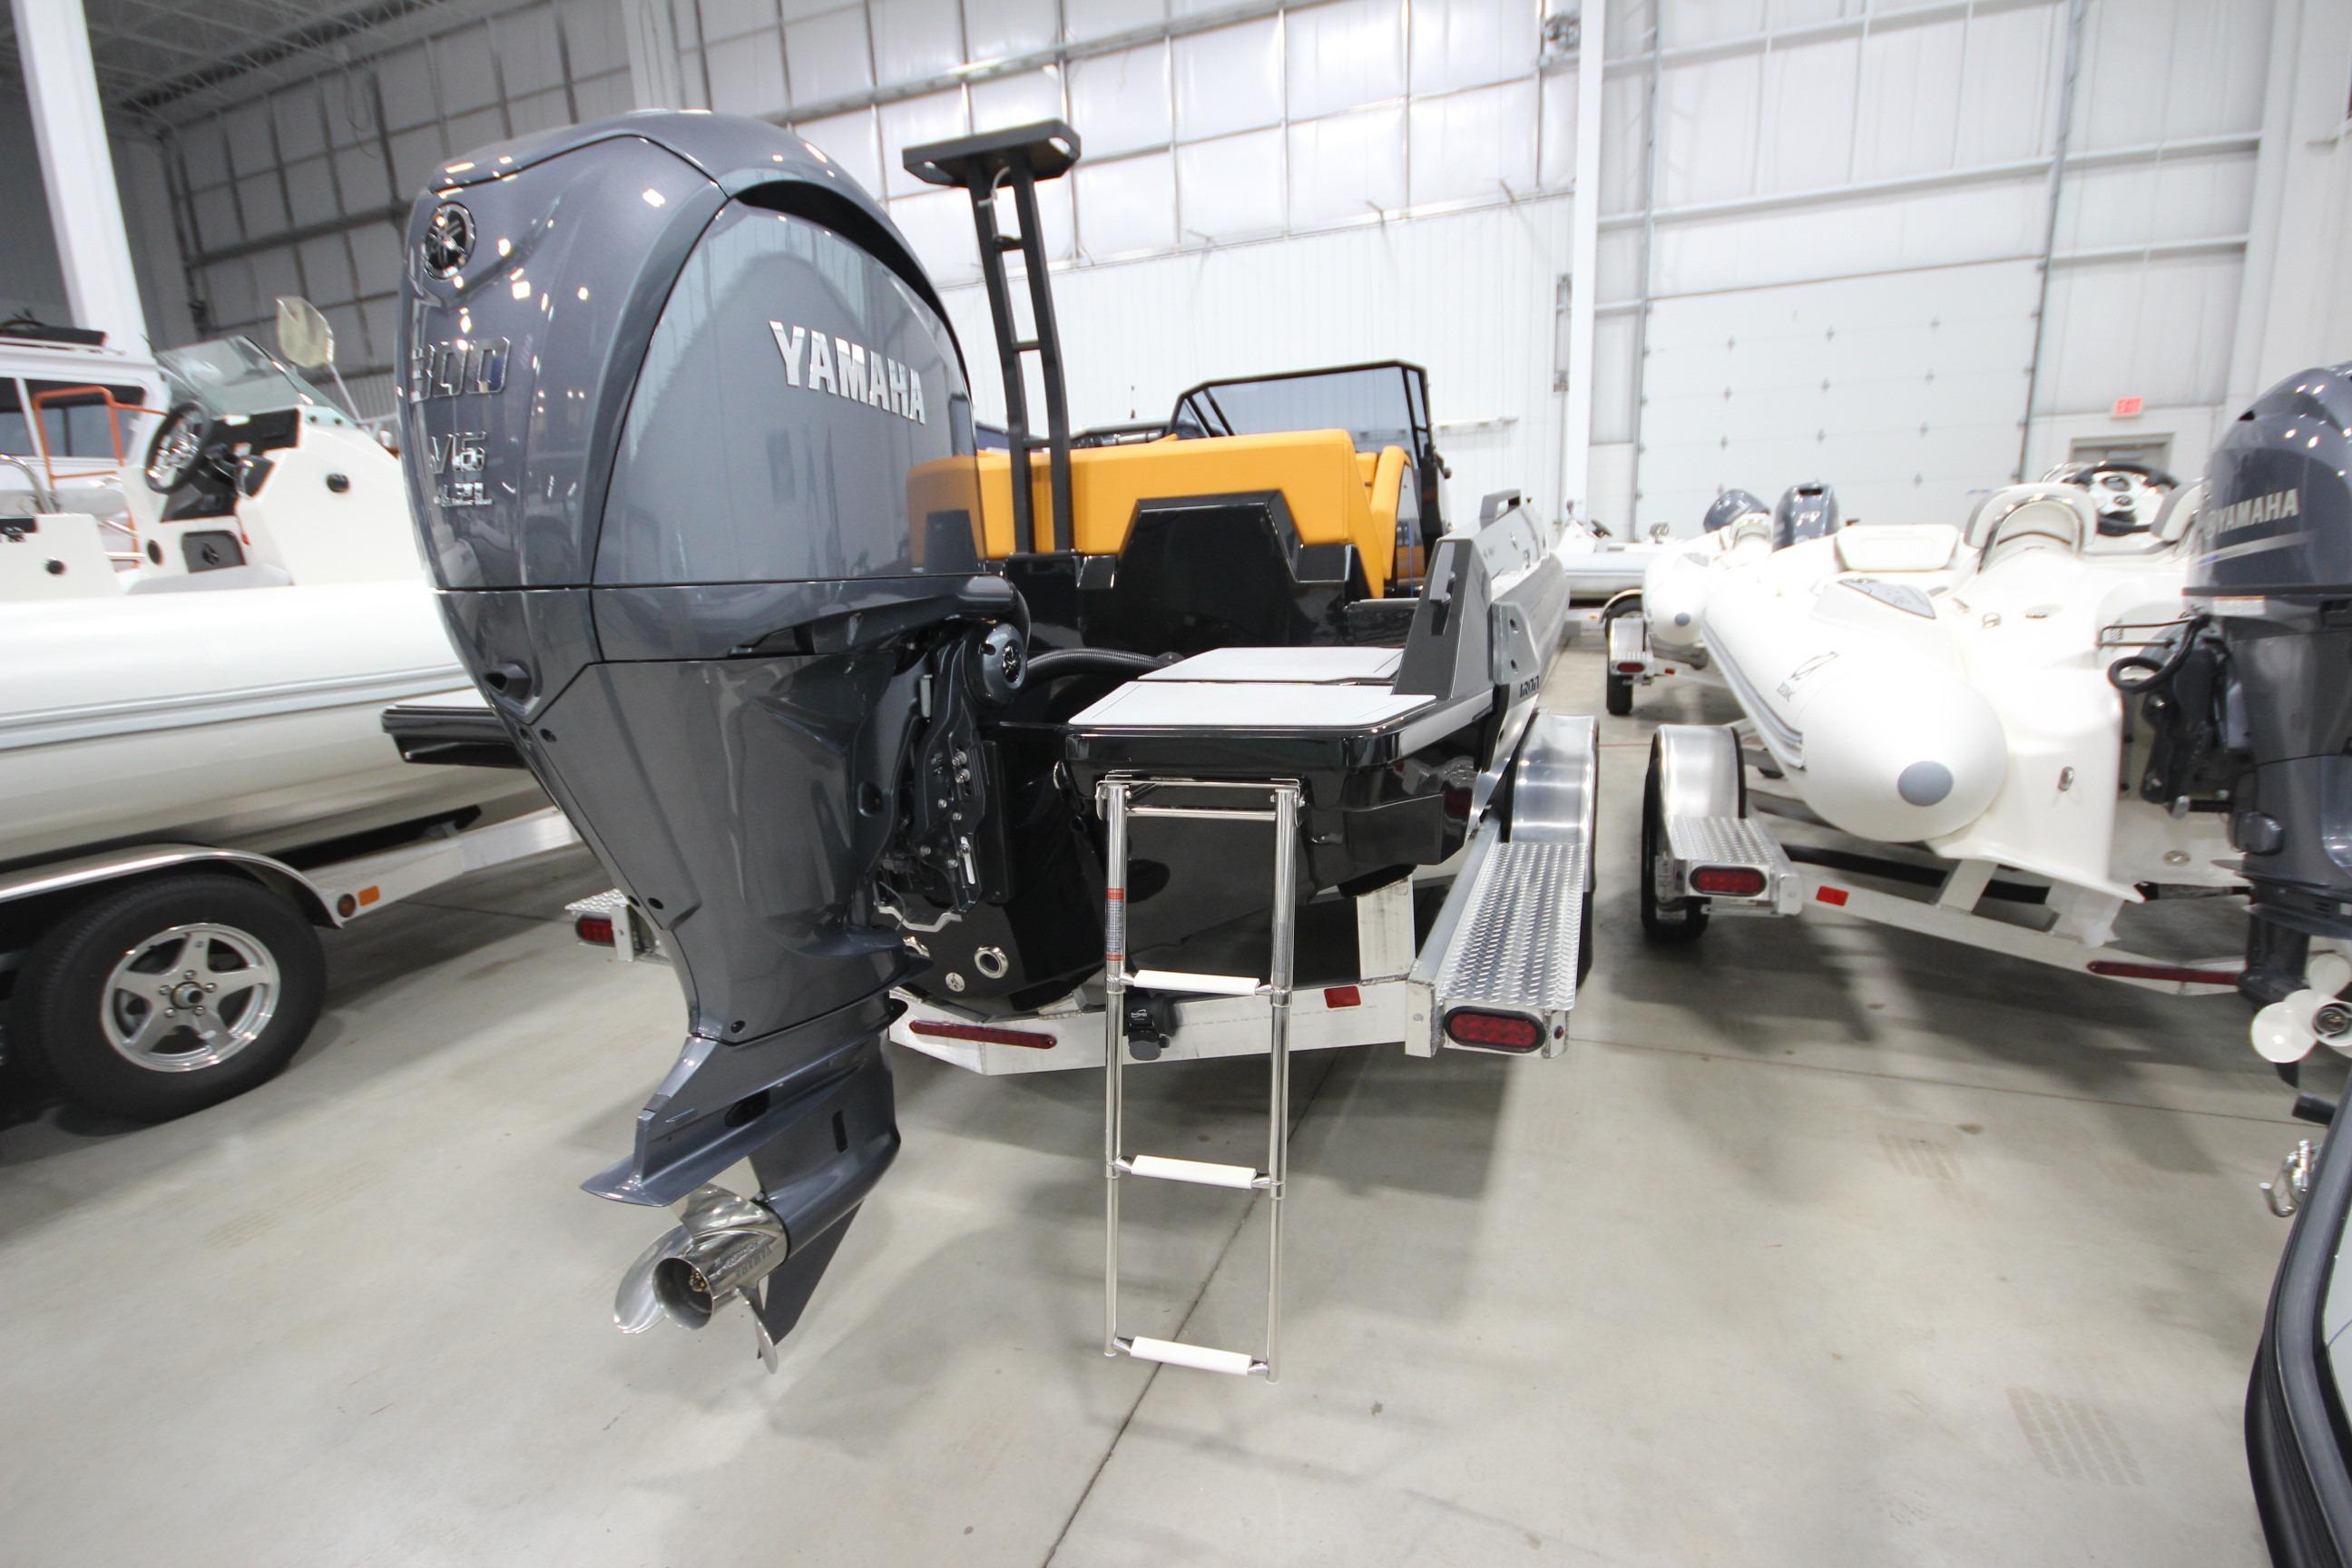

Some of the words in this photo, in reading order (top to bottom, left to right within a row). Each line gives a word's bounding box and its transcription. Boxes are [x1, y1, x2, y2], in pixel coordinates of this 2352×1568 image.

[769, 320, 926, 425] YAMAHA
[429, 431, 487, 475] V6
[2217, 488, 2300, 535] YAMAHA
